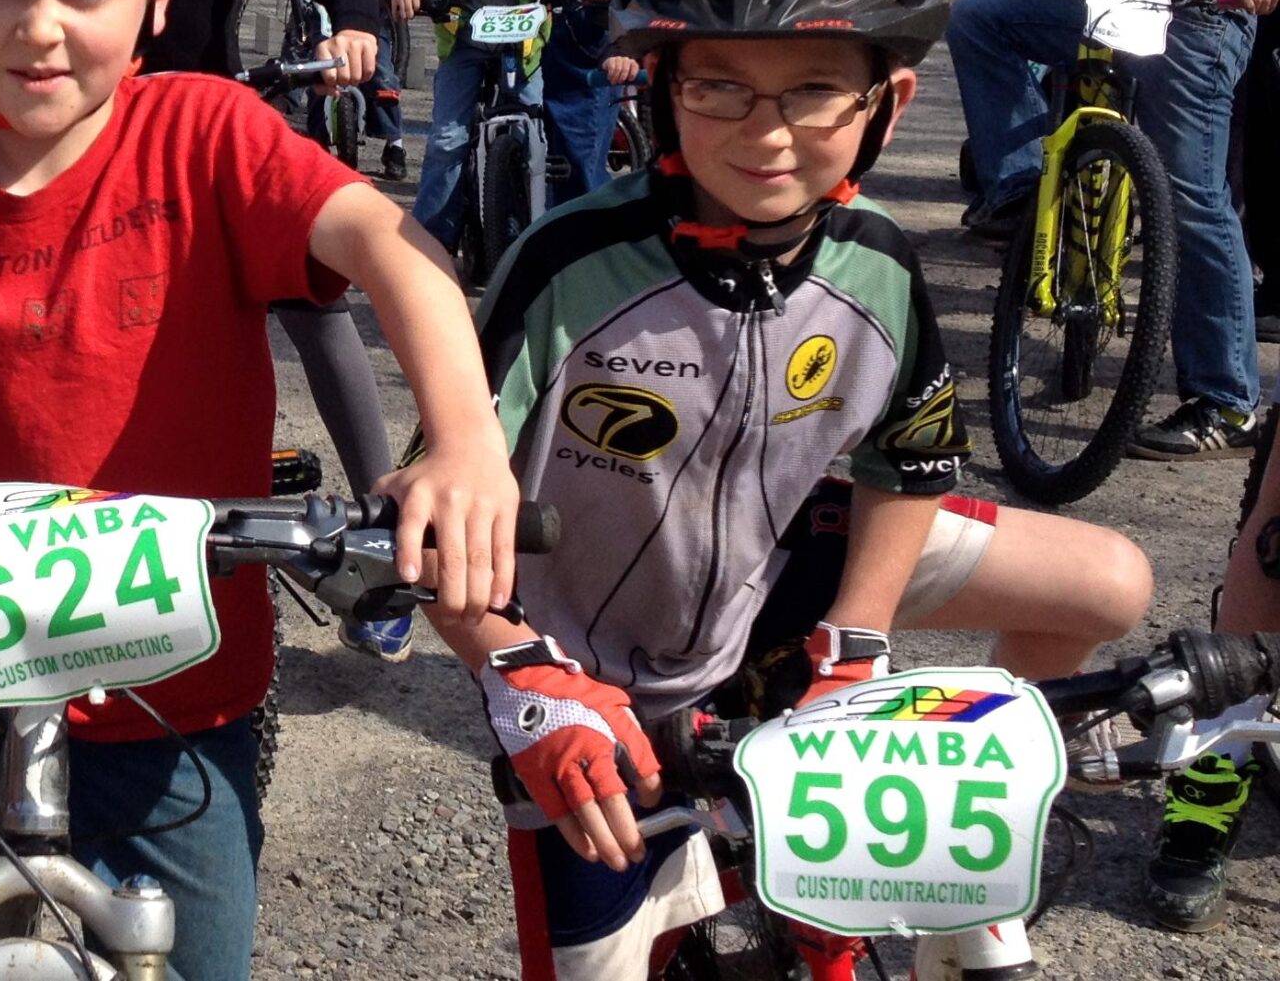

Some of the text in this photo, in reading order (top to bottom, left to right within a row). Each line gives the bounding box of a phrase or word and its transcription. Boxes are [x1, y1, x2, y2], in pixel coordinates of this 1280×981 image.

[481, 20, 533, 33] 630
[584, 349, 700, 378] seven
[556, 444, 656, 485] cycles
[63, 634, 174, 671] CONTRACTING
[788, 729, 1015, 770] WVMBA
[784, 771, 1013, 872] 595
[795, 874, 988, 906] CUSTOM CONTRACTING
